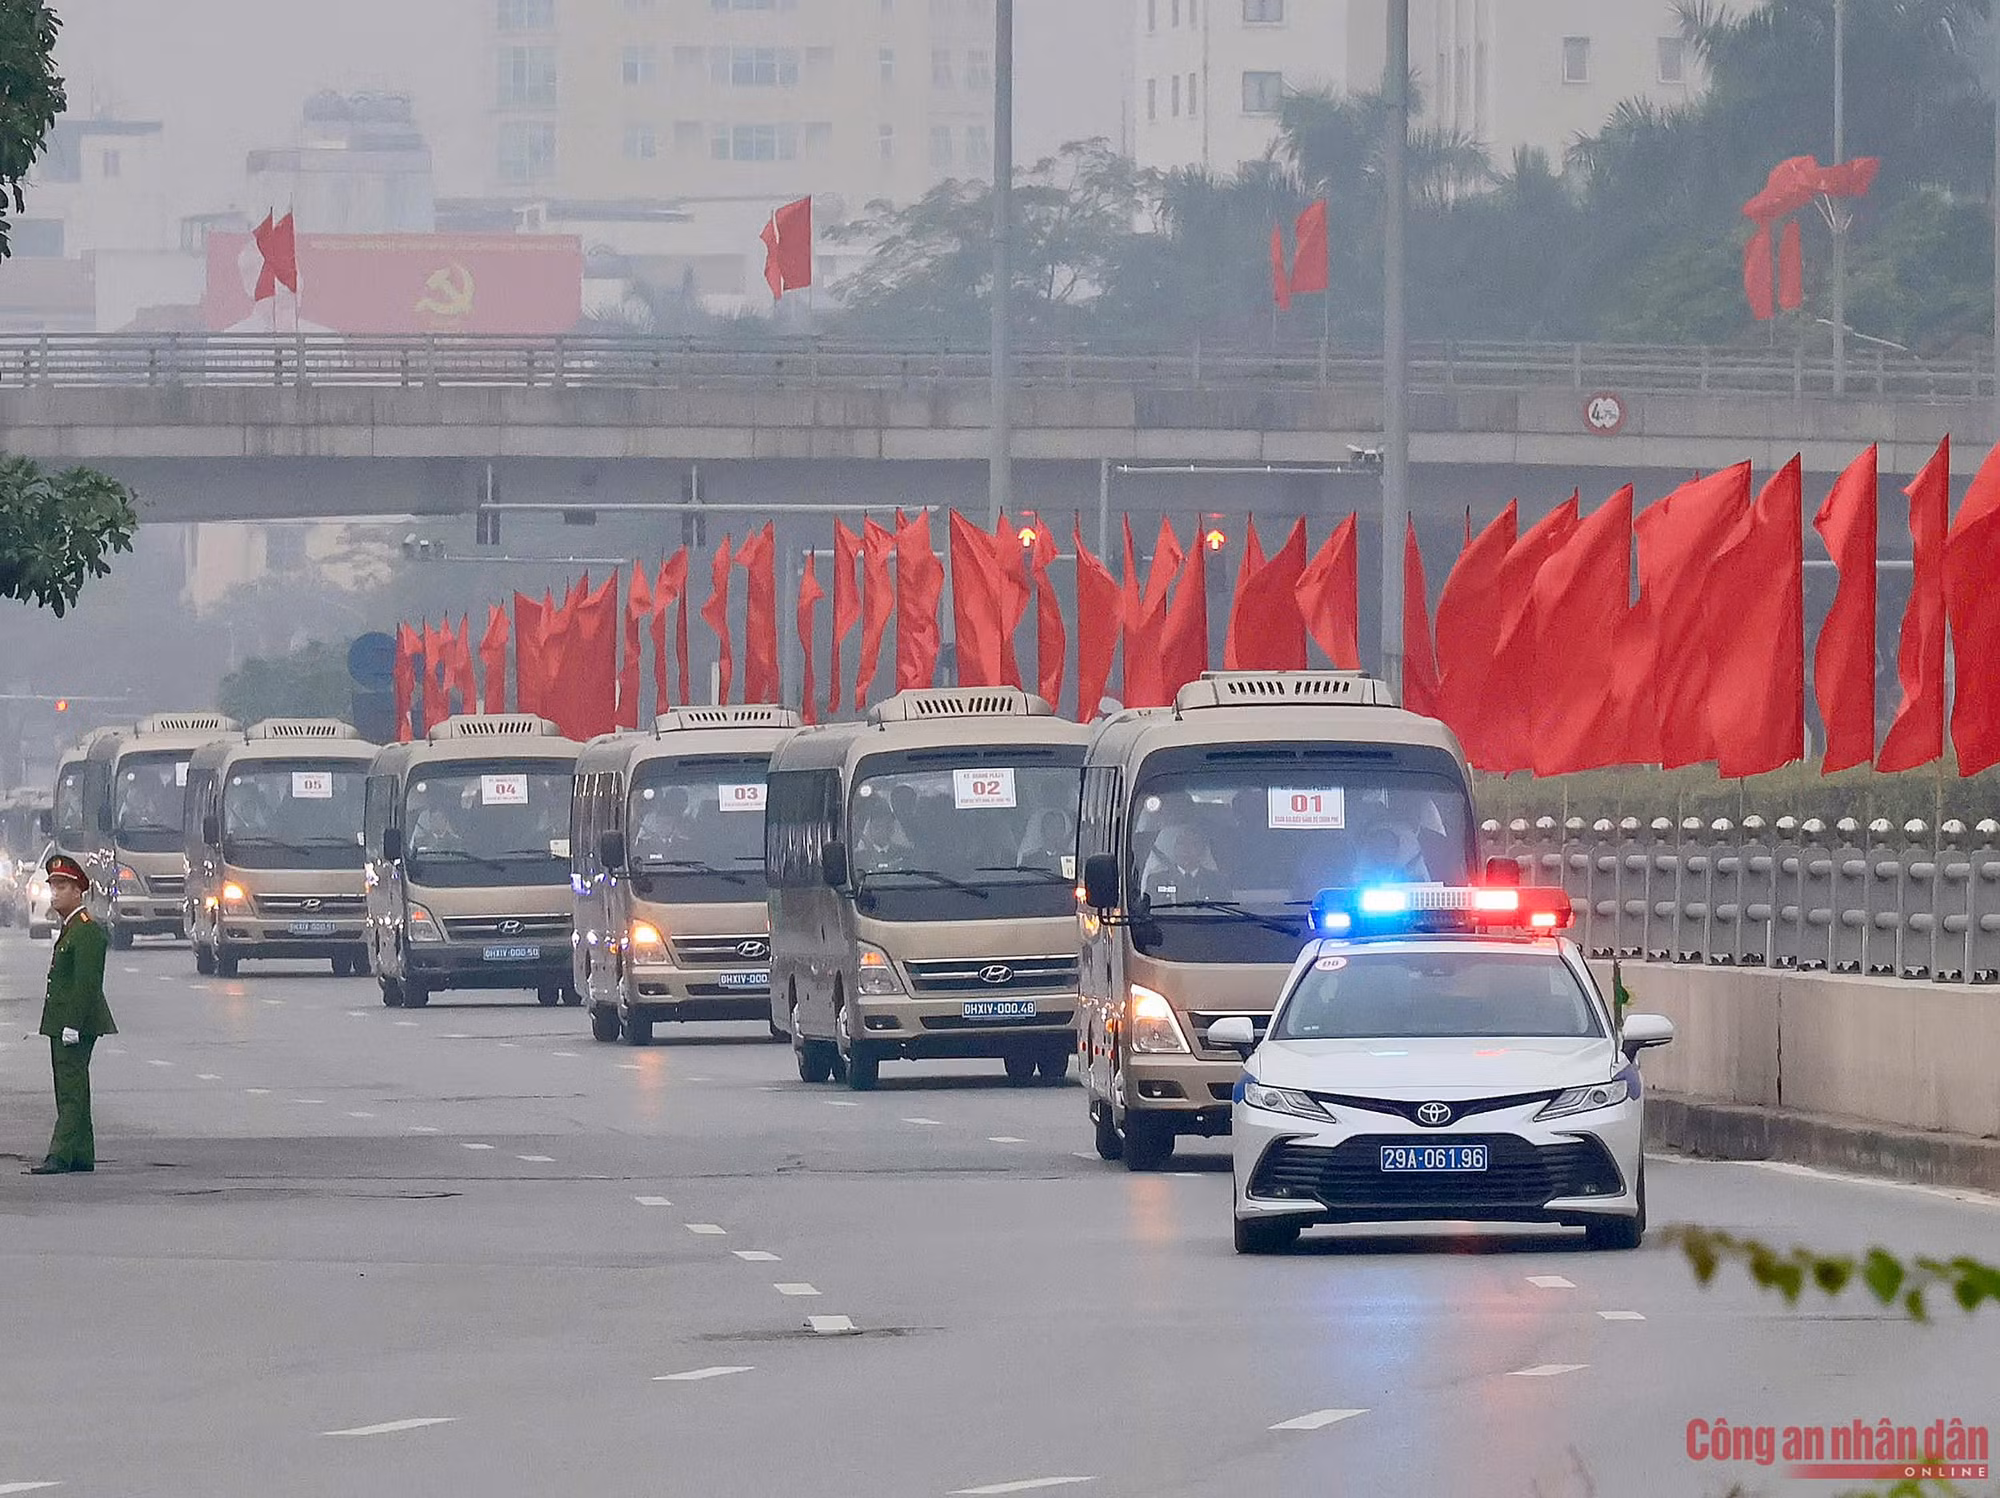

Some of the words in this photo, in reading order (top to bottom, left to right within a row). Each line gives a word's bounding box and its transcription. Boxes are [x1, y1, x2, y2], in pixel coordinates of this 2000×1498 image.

[304, 780, 322, 790] 05
[495, 783, 516, 795] 04
[972, 780, 1001, 795] 02
[734, 787, 758, 800] 03
[1291, 794, 1322, 813] 01
[1384, 1148, 1483, 1169] 29A-061.96
